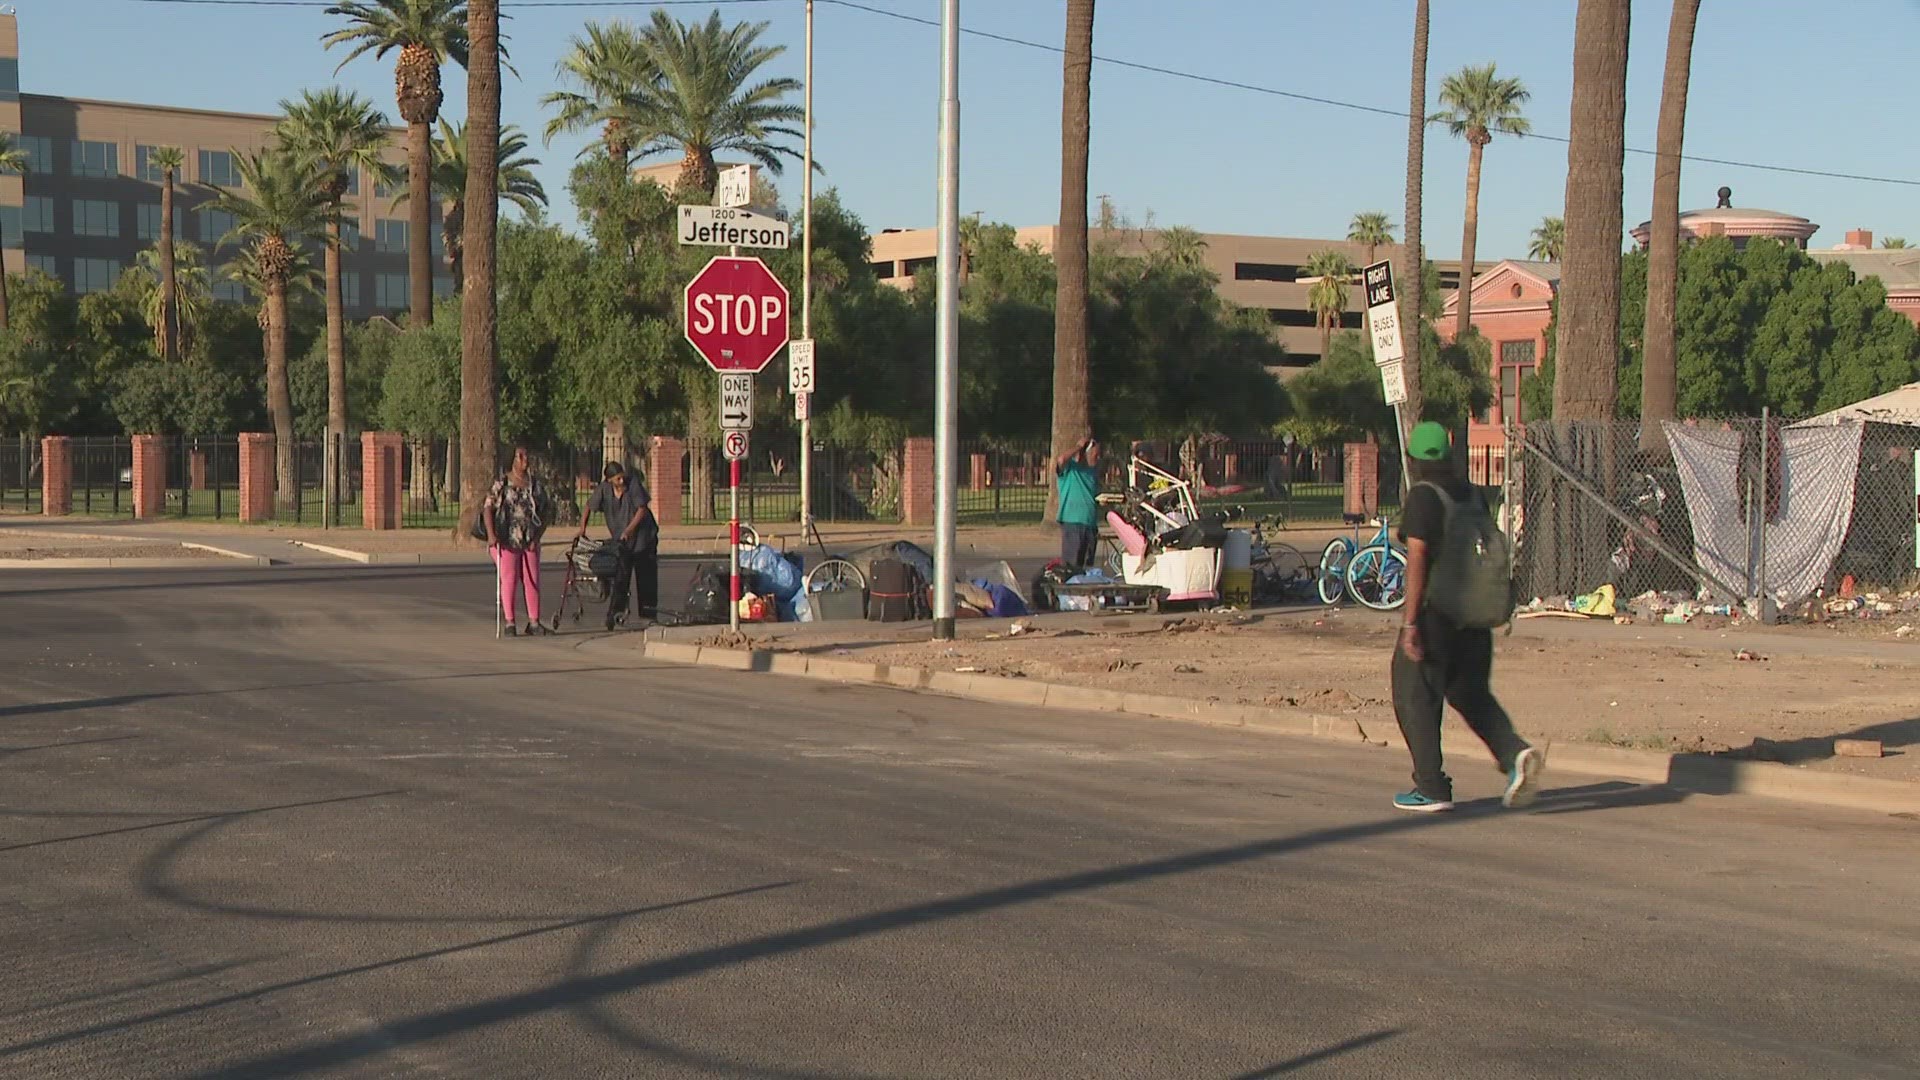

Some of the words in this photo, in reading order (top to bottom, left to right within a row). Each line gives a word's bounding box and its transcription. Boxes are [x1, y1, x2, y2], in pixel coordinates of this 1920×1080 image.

[735, 183, 747, 203] Av
[684, 208, 692, 217] W
[711, 209, 736, 220] 1200
[685, 221, 784, 246] Jefferson
[1367, 265, 1387, 286] RIGHT
[1370, 286, 1390, 305] LANE
[694, 293, 782, 336] STOP
[1373, 315, 1395, 333] BUSES
[792, 344, 811, 354] SPEED
[1378, 333, 1394, 349] ONLY
[793, 355, 809, 365] LIMIT
[724, 379, 749, 392] ONE
[792, 366, 811, 388] 35
[724, 395, 749, 408] WAY
